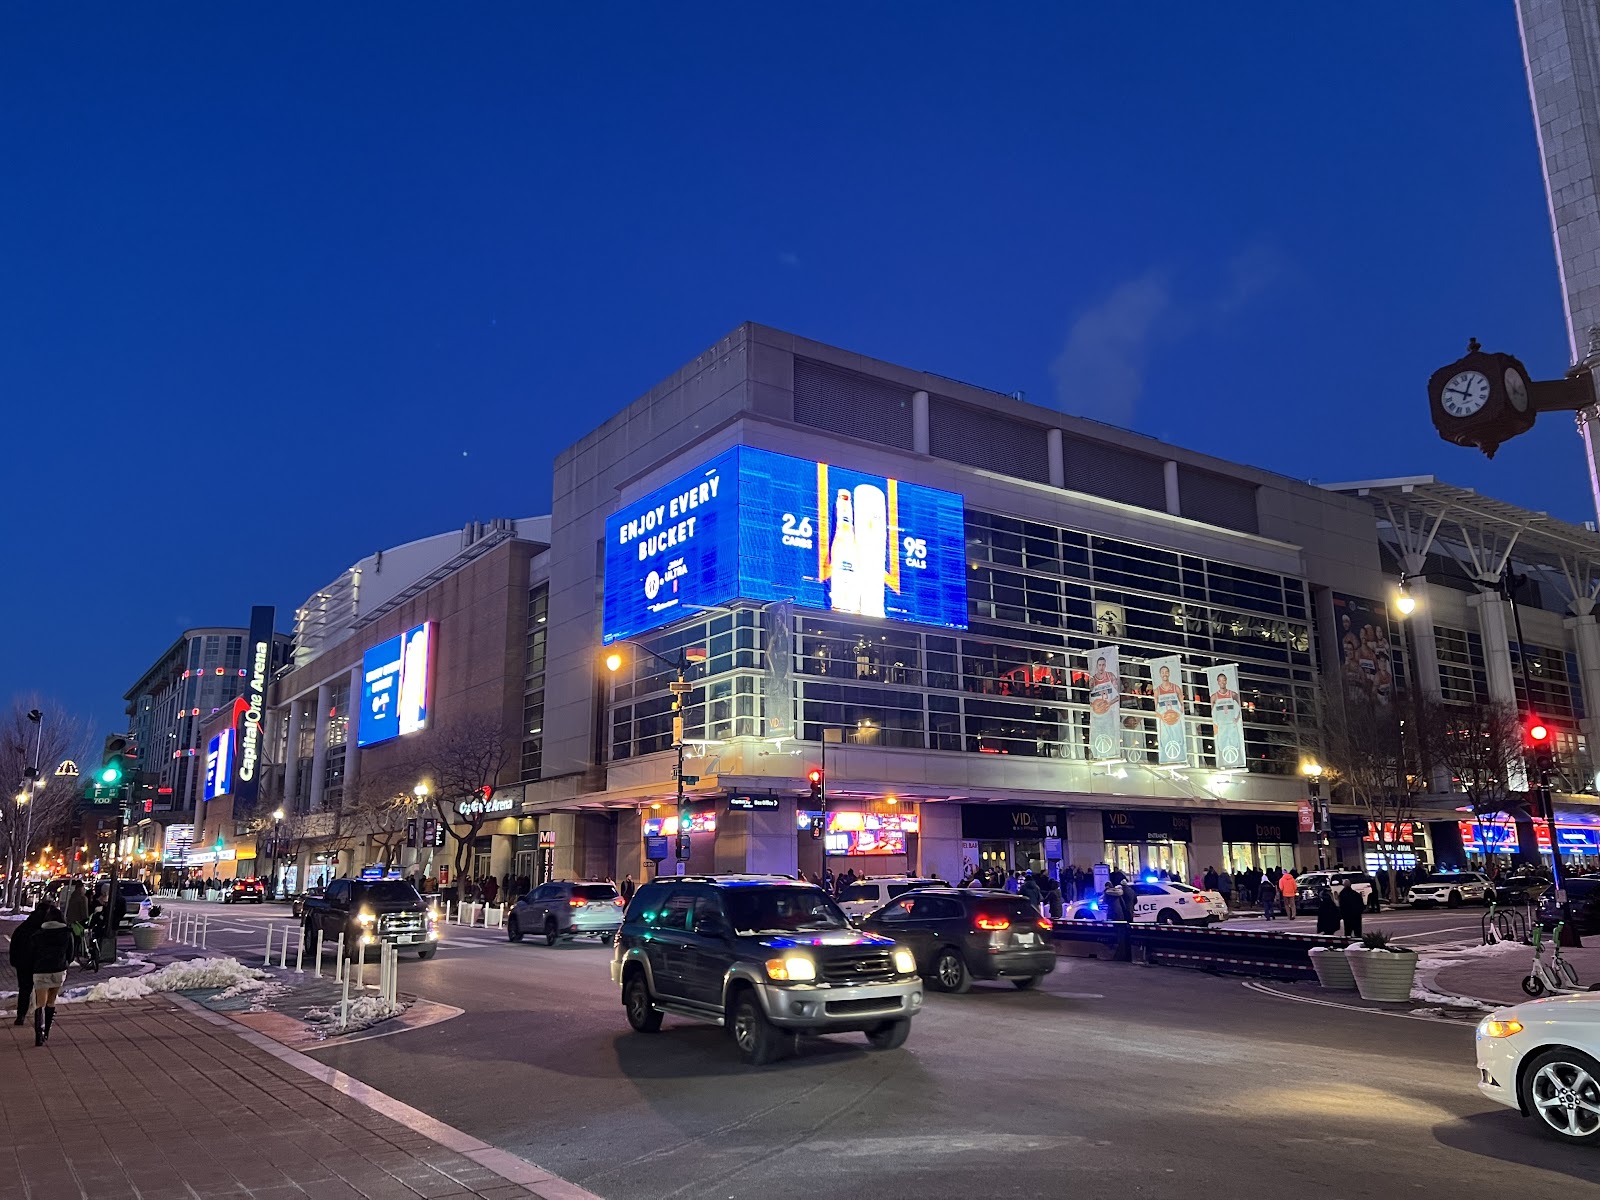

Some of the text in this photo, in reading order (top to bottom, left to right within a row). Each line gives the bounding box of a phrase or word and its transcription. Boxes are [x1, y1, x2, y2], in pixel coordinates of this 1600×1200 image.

[619, 475, 720, 544] ENJOY EVERY
[781, 513, 813, 538] 2.6
[638, 516, 697, 561] BUCKET
[782, 534, 813, 549] CARBS
[903, 536, 927, 558] 95
[905, 557, 927, 569] CALS
[664, 563, 688, 582] ULTRA
[250, 641, 268, 693] Arena
[94, 788, 102, 798] F
[491, 799, 513, 812] Arena
[1011, 812, 1039, 826] VIDA
[540, 831, 551, 843] M
[1046, 825, 1058, 837] M
[1256, 823, 1281, 840] bang
[1133, 903, 1157, 912] LICE
